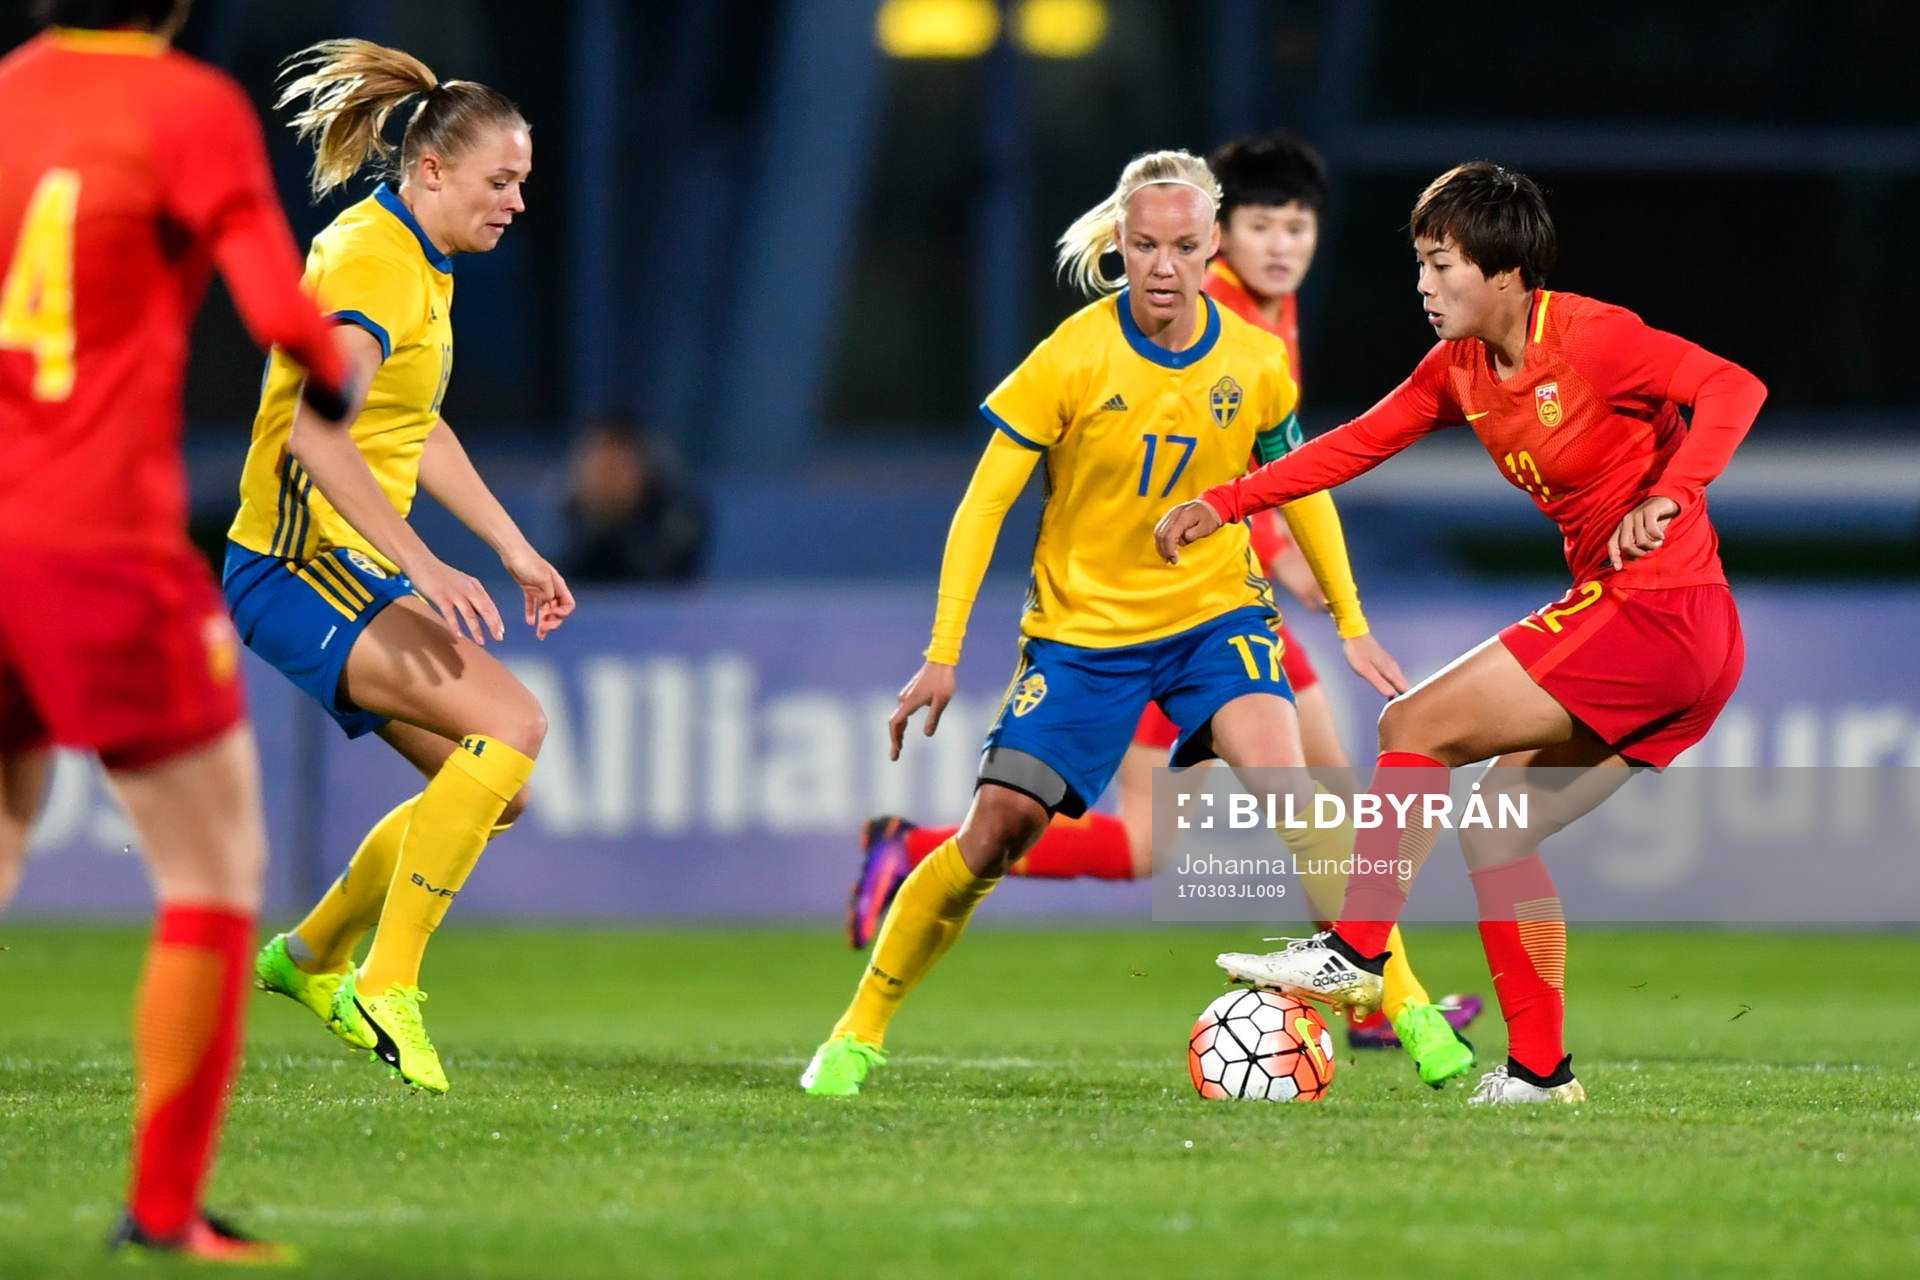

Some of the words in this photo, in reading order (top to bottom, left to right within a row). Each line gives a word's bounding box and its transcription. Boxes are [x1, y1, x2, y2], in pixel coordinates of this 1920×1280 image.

[1138, 433, 1197, 498] 17
[1228, 634, 1284, 682] 17
[1312, 971, 1358, 990] adidas
